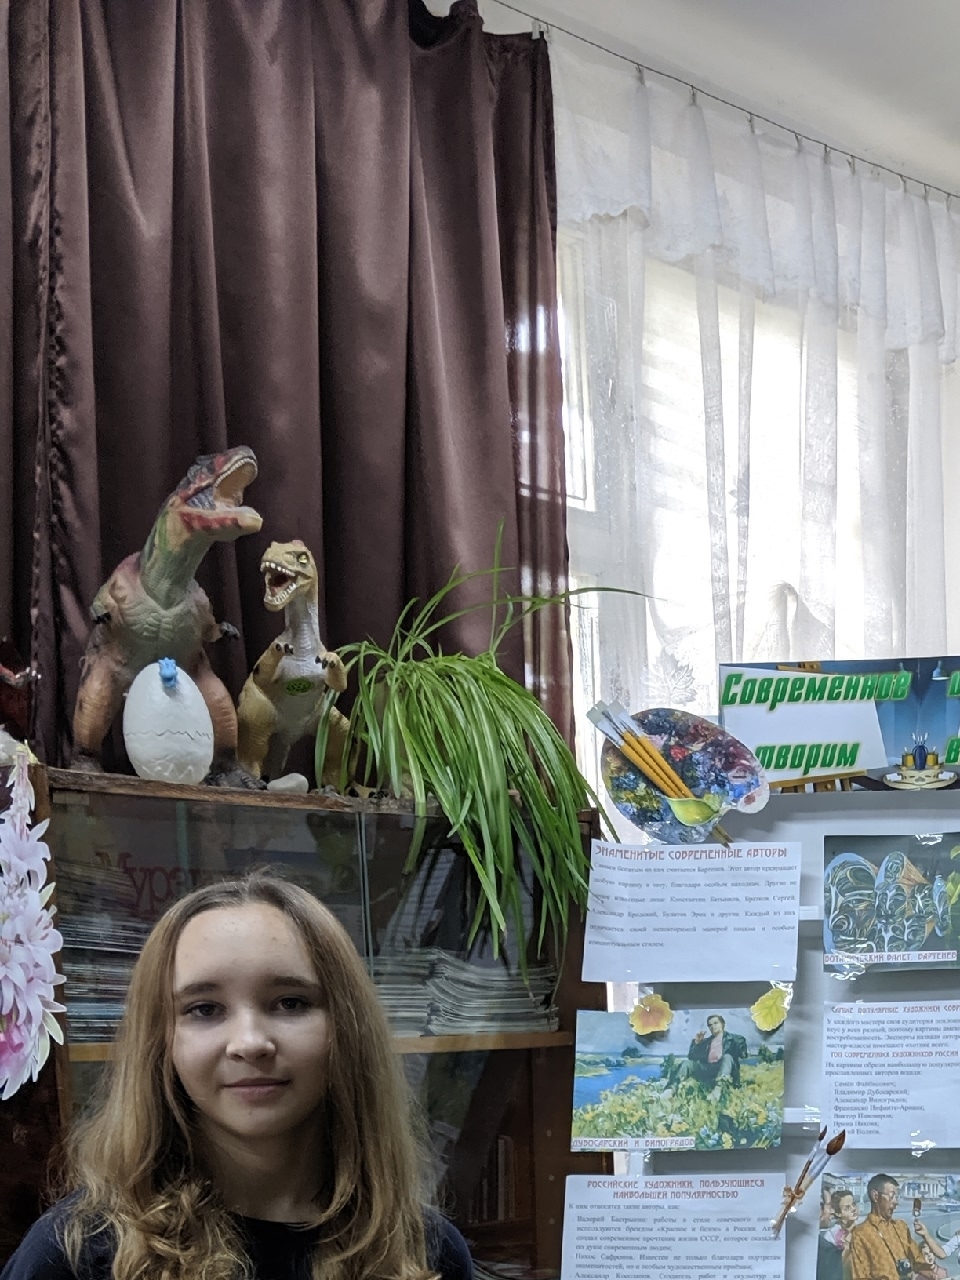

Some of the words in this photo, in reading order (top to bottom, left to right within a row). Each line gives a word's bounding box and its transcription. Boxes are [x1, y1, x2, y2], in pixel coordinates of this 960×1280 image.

[722, 671, 913, 711] Современное
[595, 845, 665, 861] ЗНАМЕНИТЫЕ
[668, 849, 743, 861] СОВРЕМЕННЫЕ
[746, 848, 788, 858] АВТОРЫ
[587, 1179, 638, 1189] РОССИЙСКИЕ
[700, 1179, 765, 1188] ПОЛЬЗУЮЩИЕСЯ
[613, 1190, 667, 1199] НАИБОЛЬШЕЙ
[670, 1190, 739, 1199] ПОПУЛЯРНОСТЬЮ
